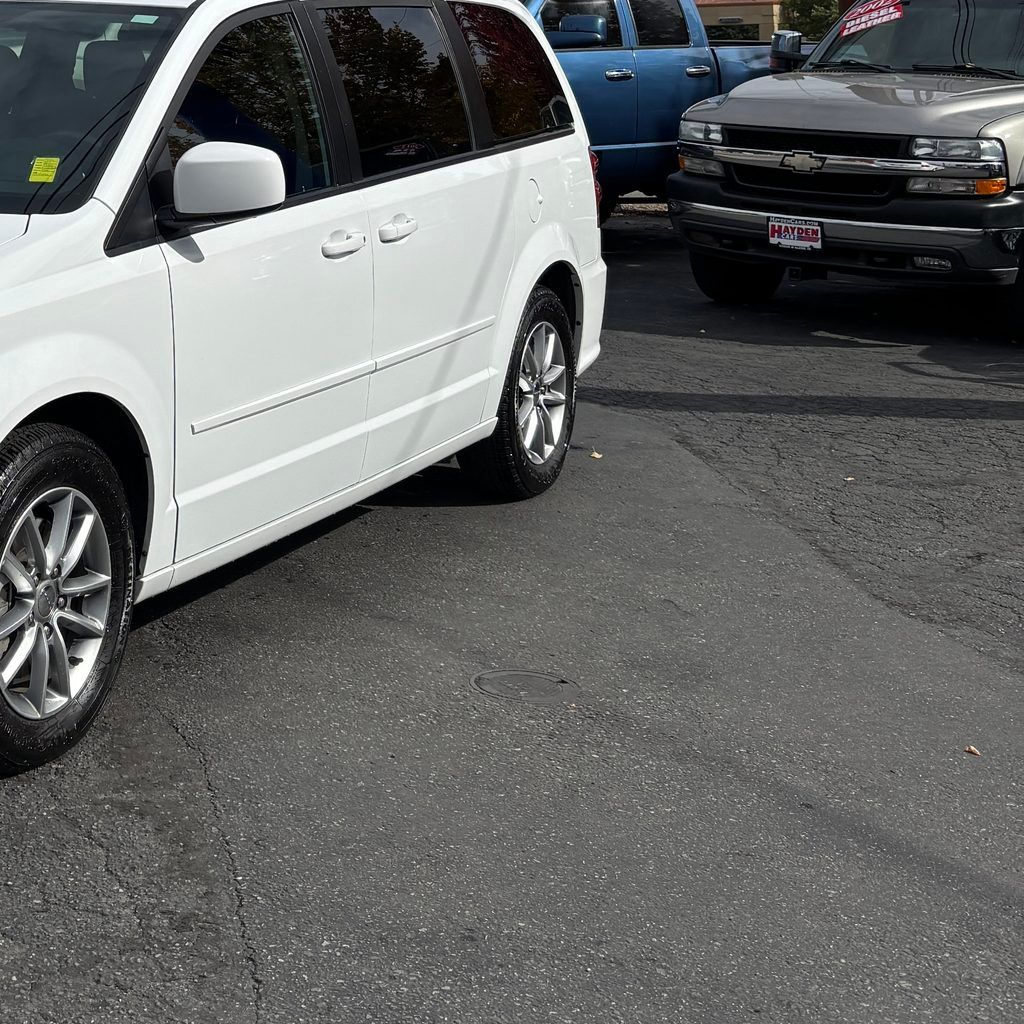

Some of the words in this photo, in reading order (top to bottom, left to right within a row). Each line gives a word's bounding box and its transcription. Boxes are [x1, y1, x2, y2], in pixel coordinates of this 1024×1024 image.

[842, 11, 902, 36] LEATHER
[845, 6, 898, 28] DIESEL
[770, 224, 819, 238] HAYDEN
